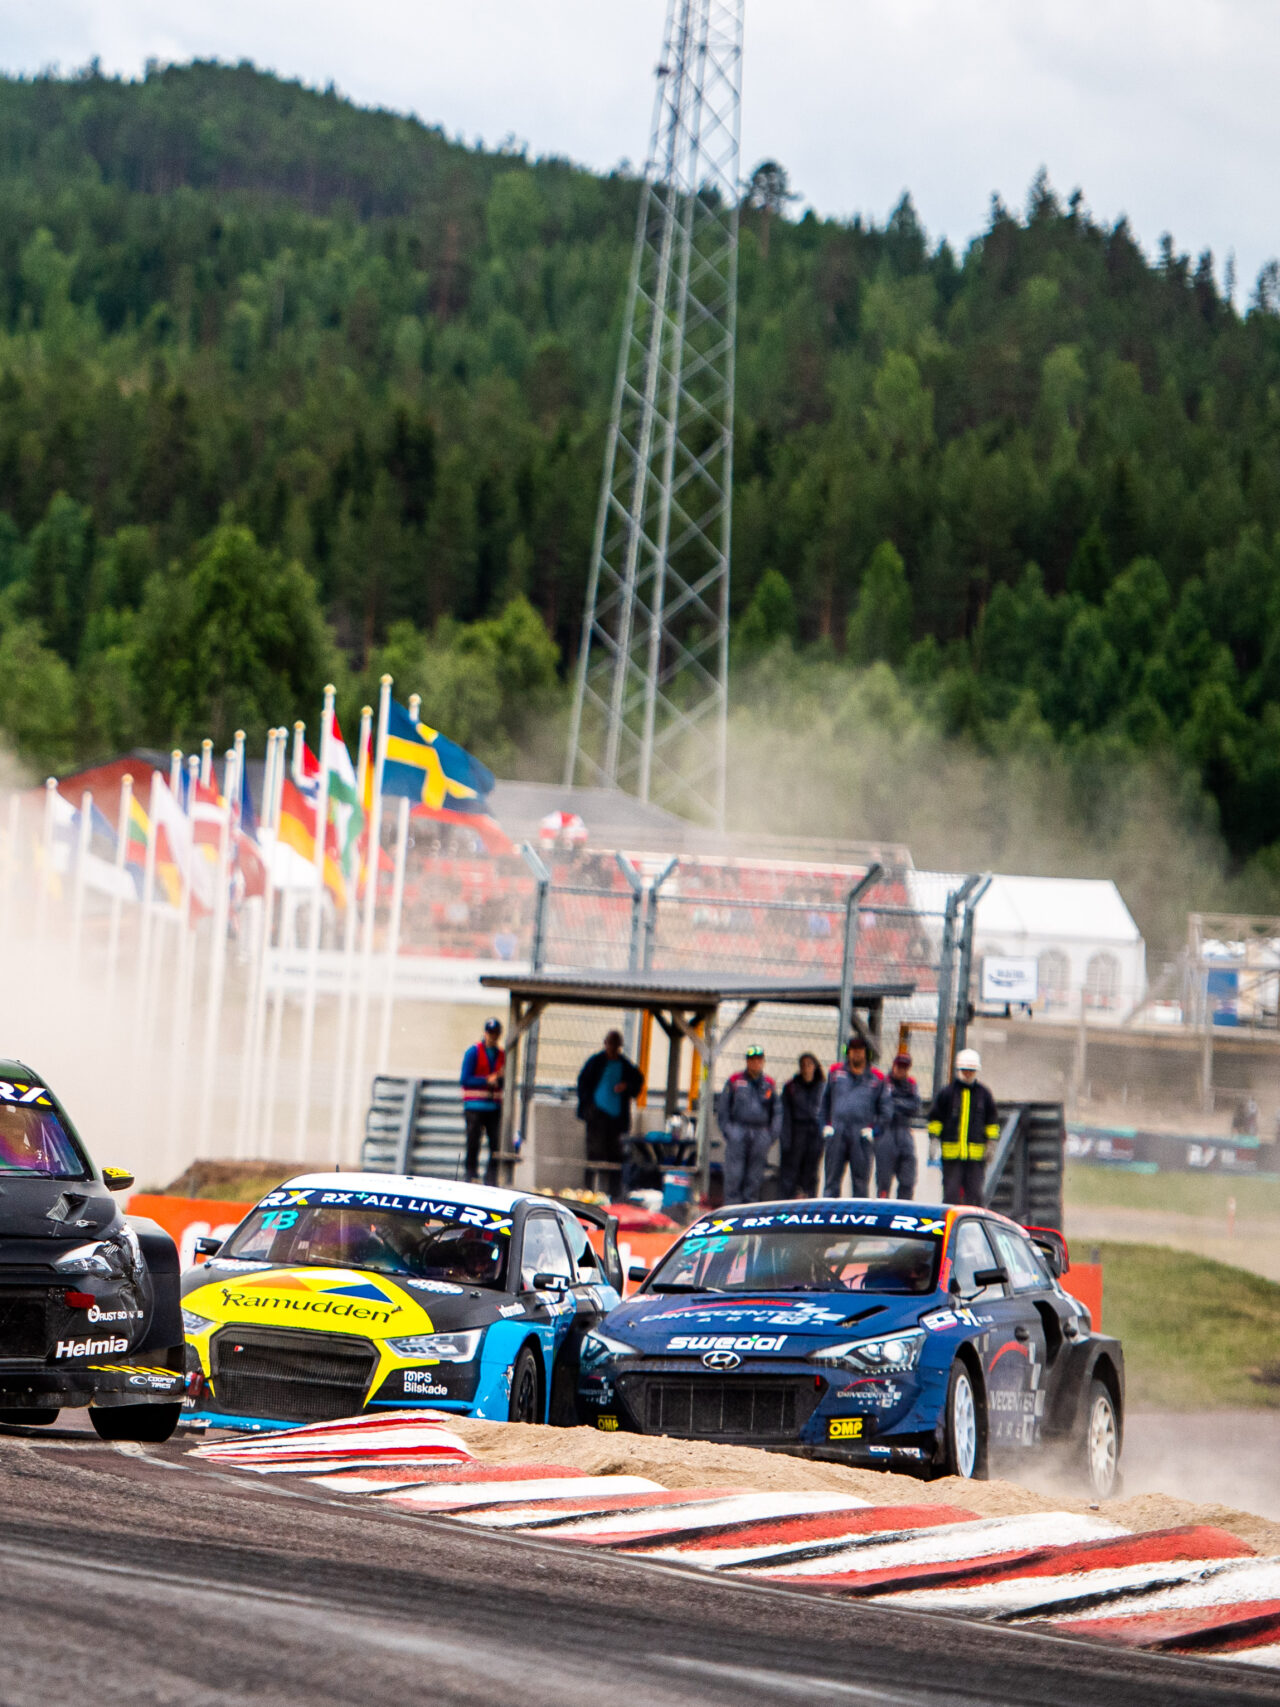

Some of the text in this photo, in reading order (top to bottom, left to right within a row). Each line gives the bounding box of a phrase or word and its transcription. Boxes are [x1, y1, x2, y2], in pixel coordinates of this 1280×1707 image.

[258, 1190, 316, 1208] RX
[408, 1198, 457, 1217] LIVE
[261, 1210, 299, 1230] 13
[459, 1207, 514, 1236] RX
[686, 1217, 739, 1238] RX
[829, 1215, 878, 1226] LIVE
[890, 1215, 946, 1236] RX
[682, 1236, 729, 1256] 92
[222, 1292, 393, 1324] Ramudden
[55, 1336, 129, 1359] Helmia
[666, 1335, 788, 1352] swedol
[147, 1376, 176, 1384] COOPER
[403, 1381, 448, 1396] Bilskade
[597, 1418, 619, 1431] OMP
[829, 1421, 863, 1436] OMP
